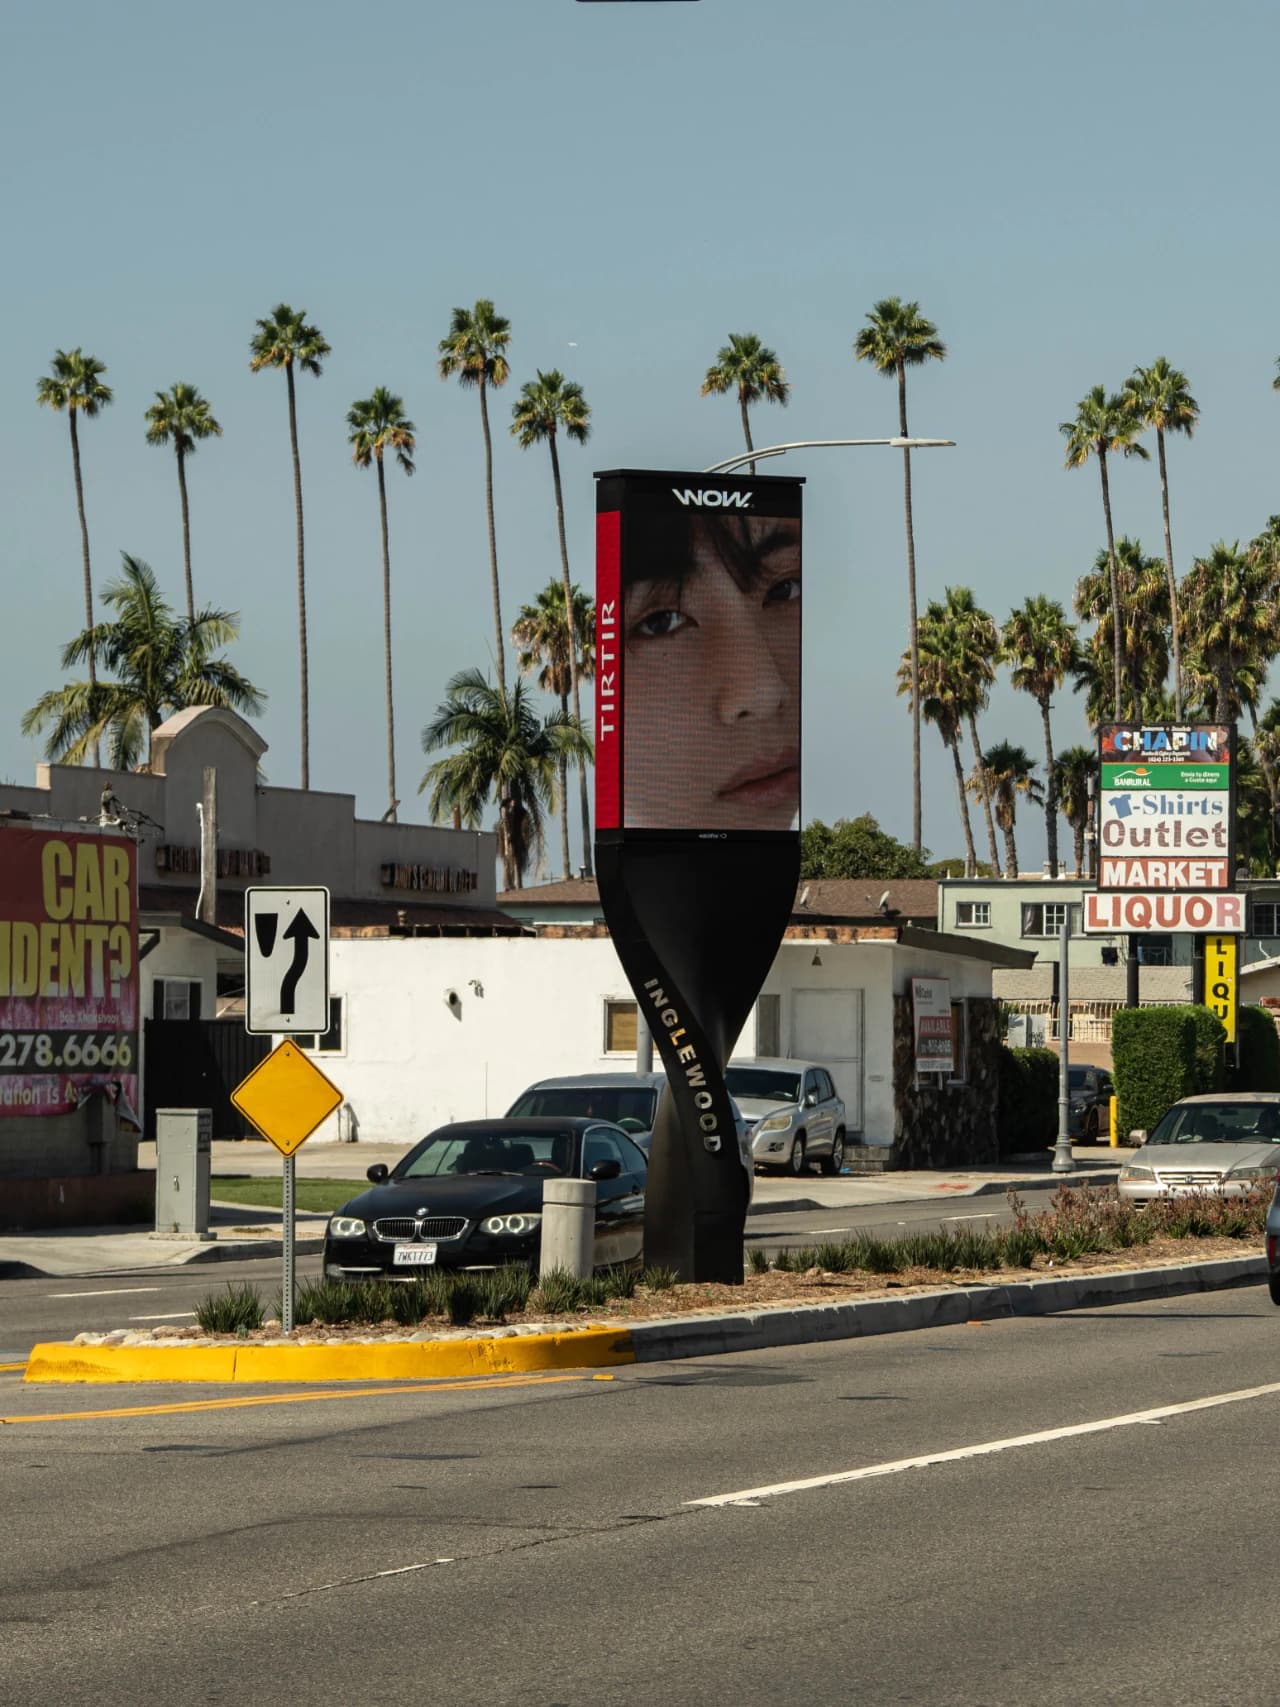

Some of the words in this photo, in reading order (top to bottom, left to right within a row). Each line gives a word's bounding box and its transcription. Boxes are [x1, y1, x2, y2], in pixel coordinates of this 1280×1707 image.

[601, 600, 615, 741] TIRTIR
[1114, 731, 1218, 751] CHAPIN
[1102, 819, 1227, 848] Outlet
[41, 839, 131, 923] CAR
[1102, 861, 1225, 887] MARKET
[1087, 896, 1241, 929] LIQUOR
[0, 1034, 132, 1068] 278.6666
[644, 978, 722, 1152] INGLEWOOD
